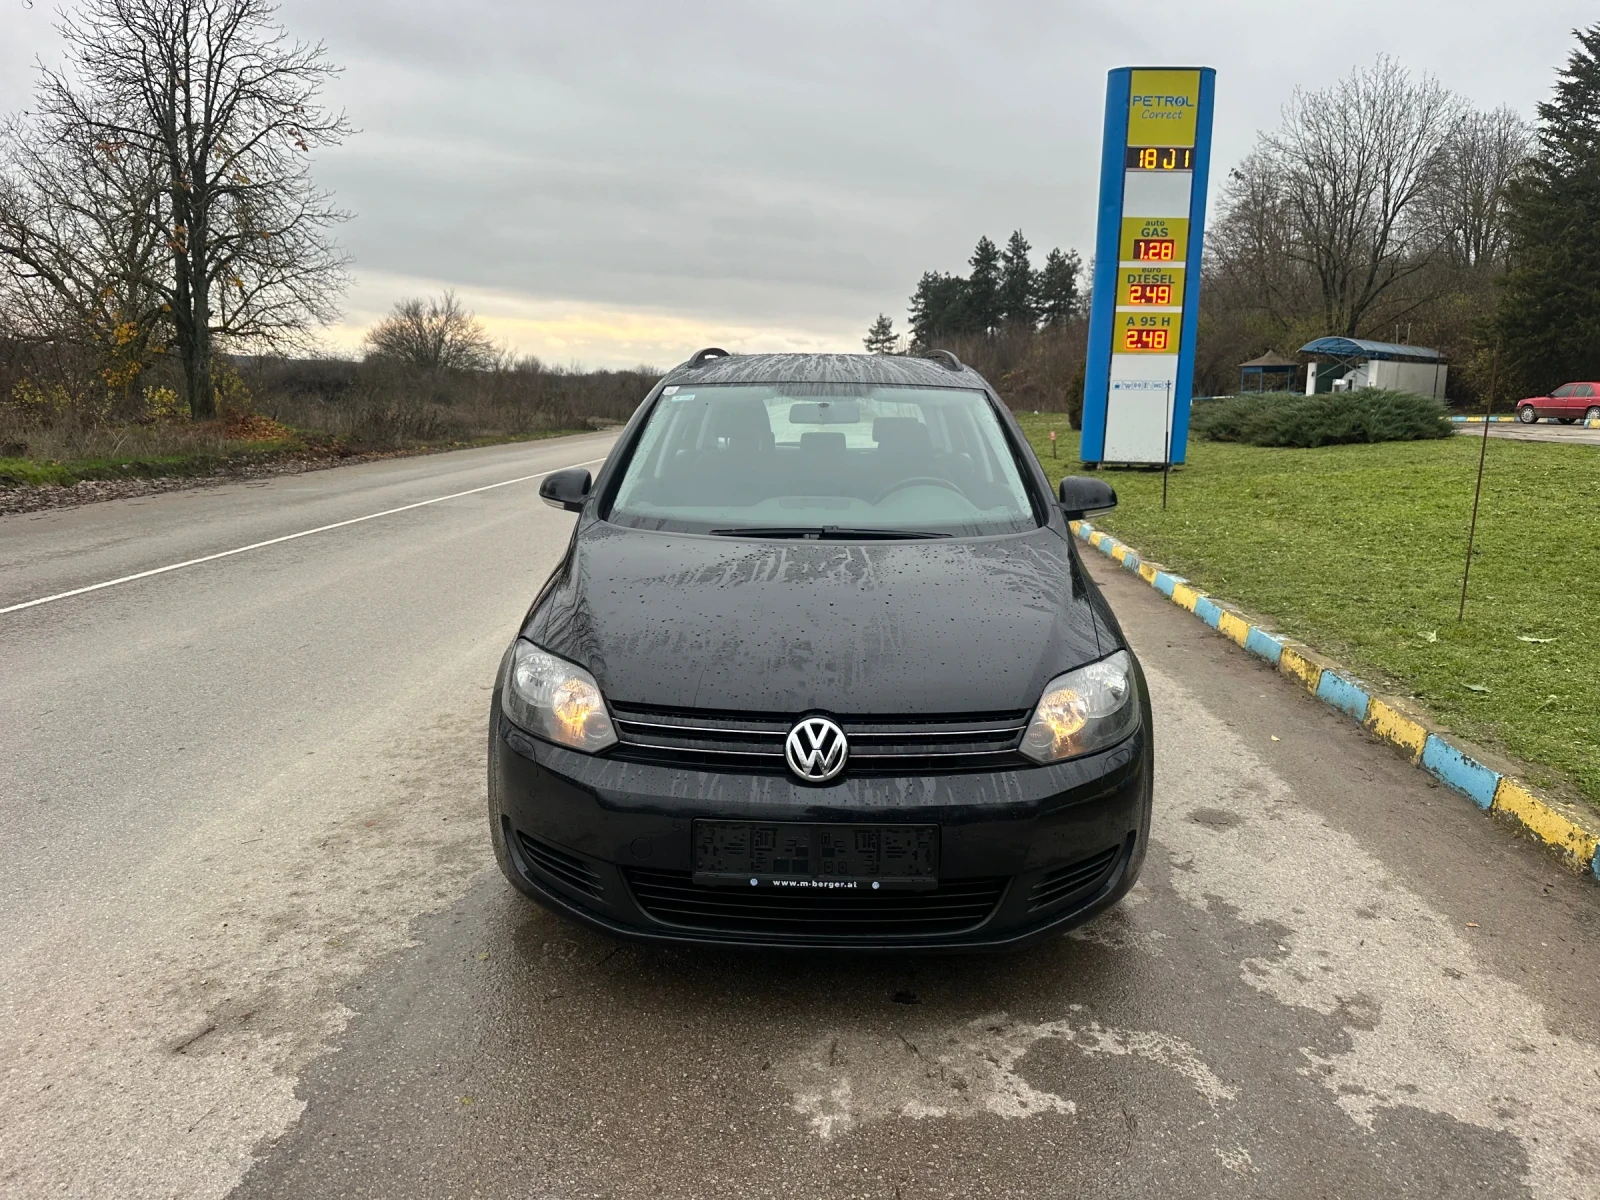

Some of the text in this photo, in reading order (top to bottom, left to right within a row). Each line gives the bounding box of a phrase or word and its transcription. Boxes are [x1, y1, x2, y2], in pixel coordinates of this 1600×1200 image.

[1132, 95, 1194, 107] PETROL
[1141, 109, 1183, 119] Correct
[1141, 227, 1168, 237] GAS
[1139, 241, 1173, 260] 1.28
[1127, 274, 1175, 284] DIESEL
[1129, 285, 1169, 303] 2.49
[1126, 316, 1171, 326] A 95 H
[1125, 330, 1166, 348] 2.48
[786, 718, 848, 782] VW
[772, 879, 858, 889] www.m-berger.at
